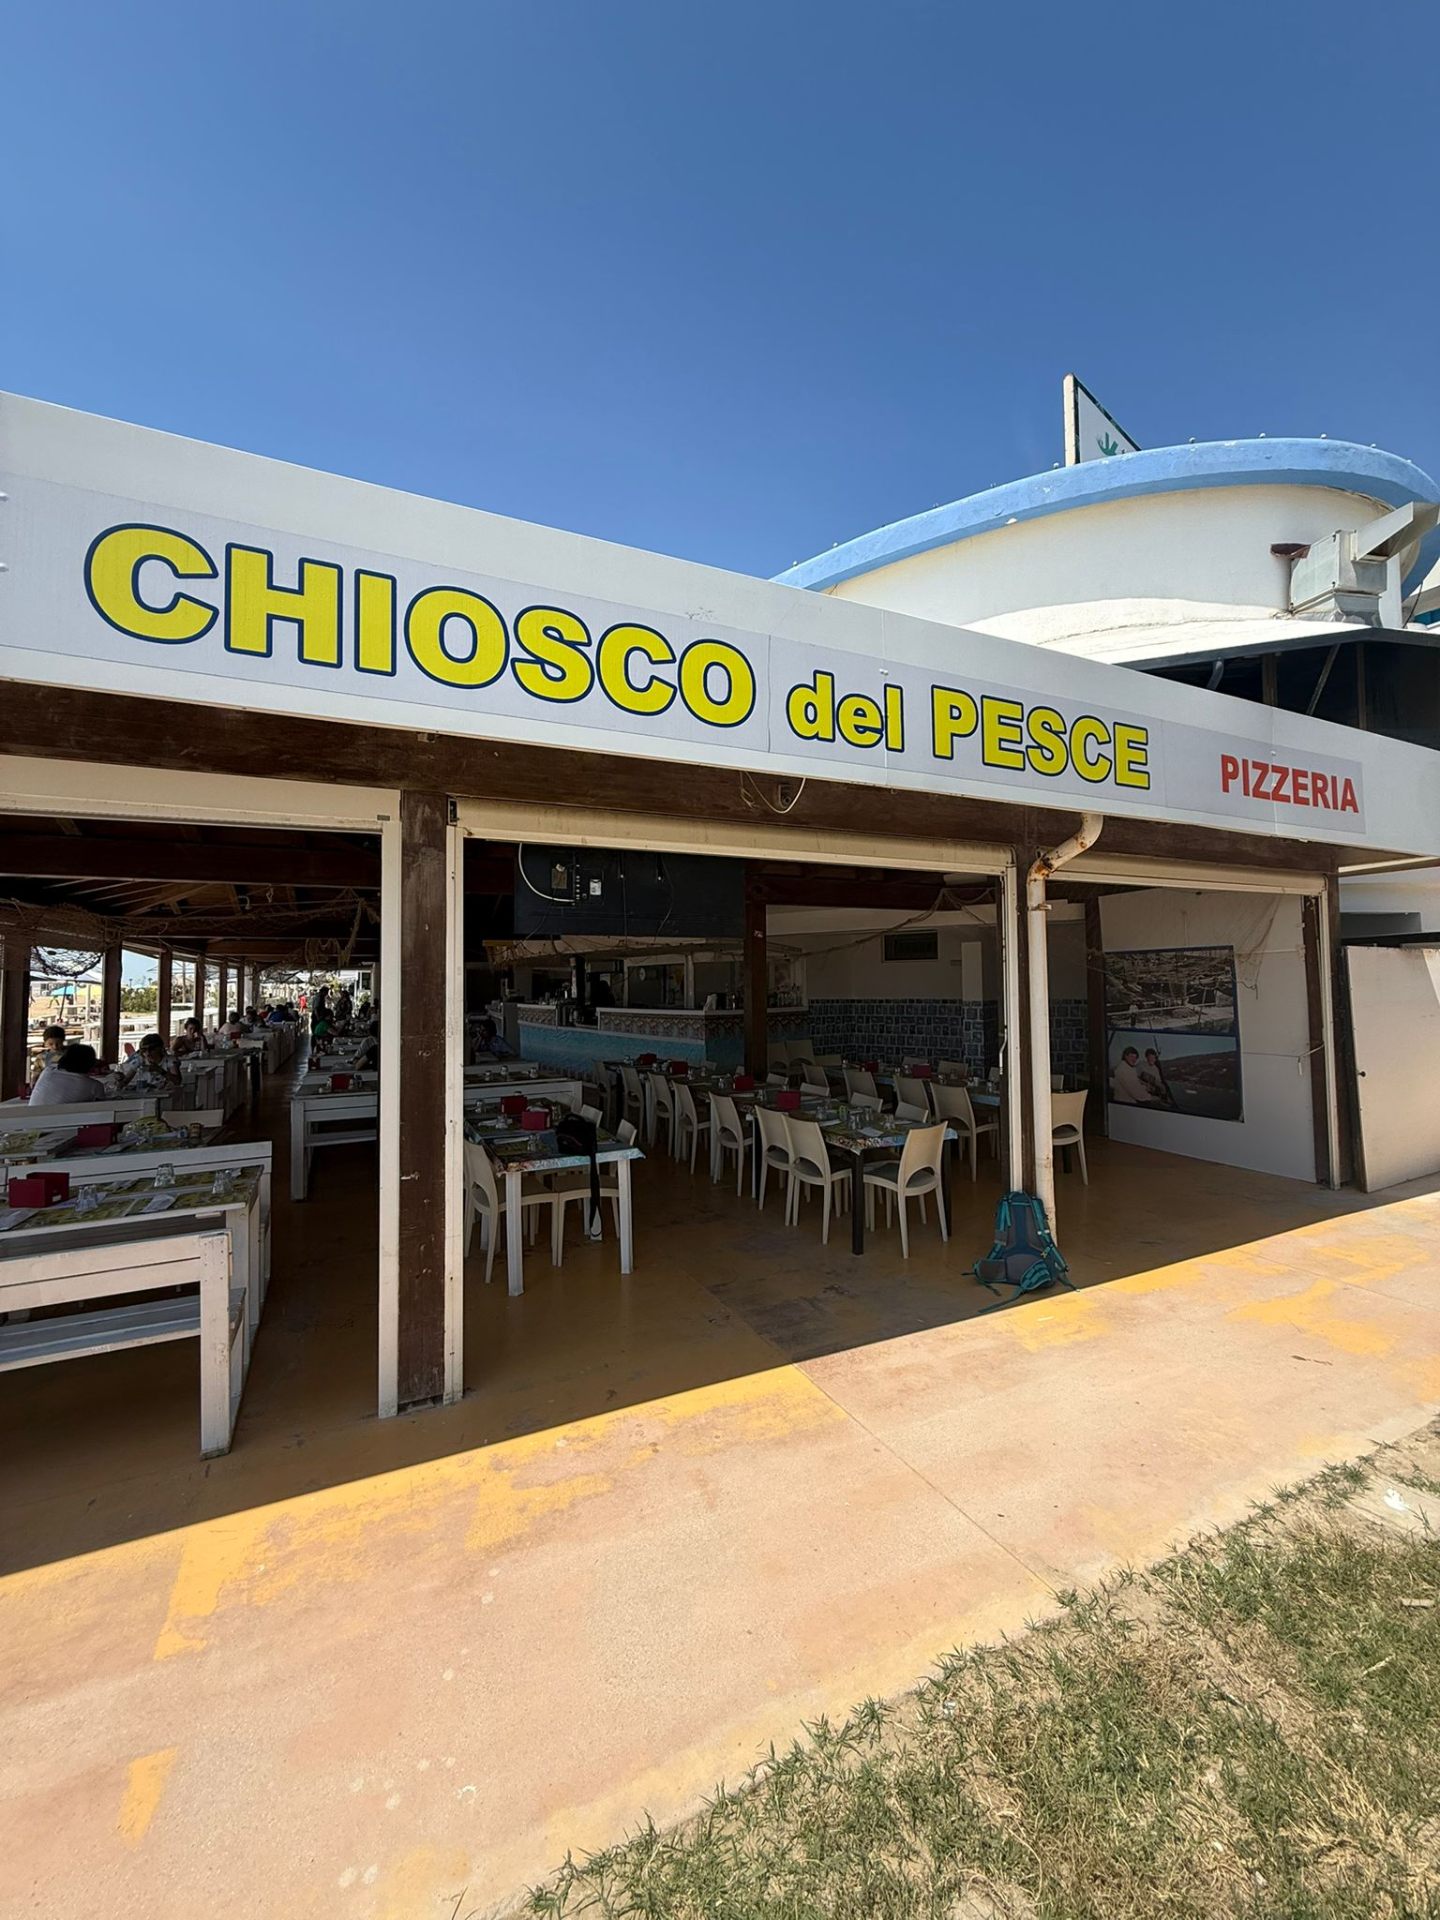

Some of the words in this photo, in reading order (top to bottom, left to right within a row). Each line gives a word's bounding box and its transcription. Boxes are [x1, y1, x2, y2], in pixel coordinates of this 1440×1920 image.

[84, 523, 756, 727] CHIOSCO
[787, 670, 905, 752] del
[931, 686, 1150, 790] PESCE
[1221, 754, 1360, 813] PIZZERIA
